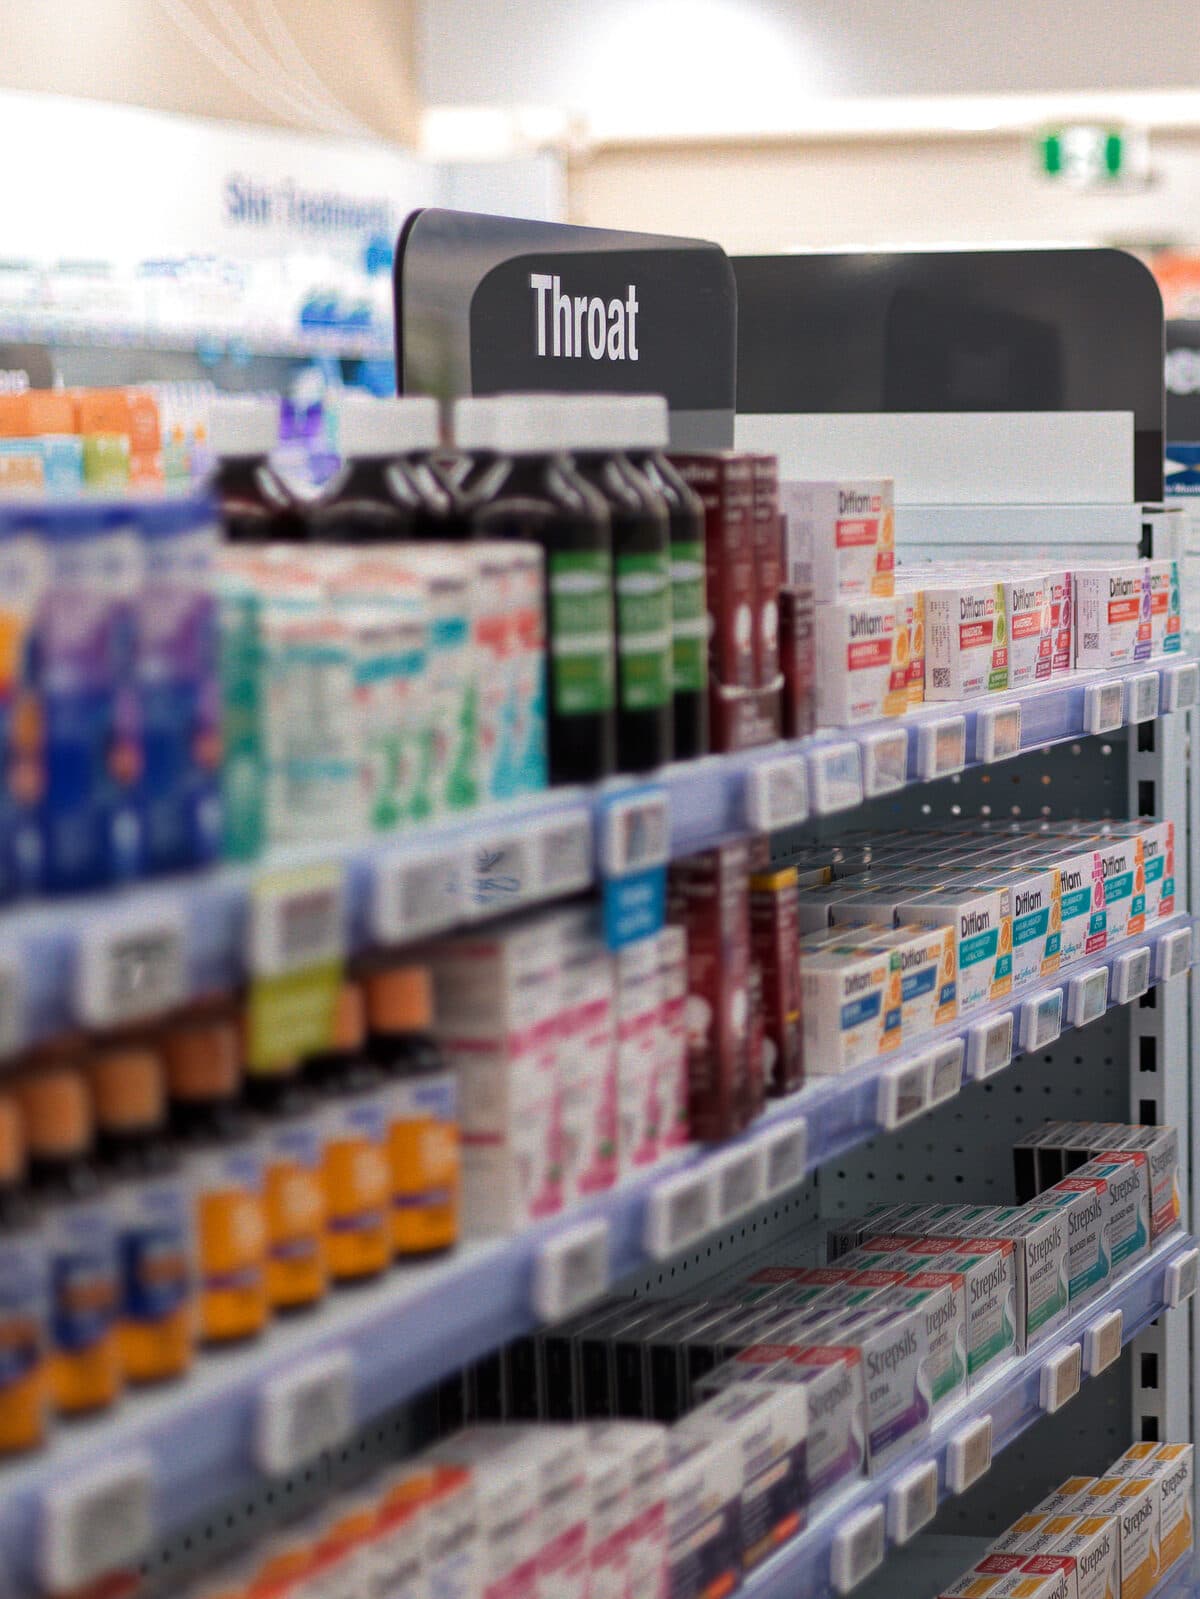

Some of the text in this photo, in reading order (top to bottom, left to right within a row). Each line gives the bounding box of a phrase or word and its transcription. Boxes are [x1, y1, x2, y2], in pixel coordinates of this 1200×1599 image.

[530, 273, 639, 361] Throat
[960, 595, 986, 620] Difflam
[1102, 855, 1127, 878] Difflam
[961, 911, 990, 938] Difflam
[1015, 891, 1042, 917] Difflam
[1109, 1170, 1140, 1206] Strepsils
[1068, 1197, 1102, 1236] Strepsils
[1028, 1226, 1061, 1268] Strepsils
[970, 1261, 1007, 1305] Strepsils
[926, 1295, 958, 1336] trepsils
[867, 1328, 918, 1380] Strepsils
[1123, 1496, 1153, 1540] Strepsils
[1079, 1533, 1110, 1579] Strepsils
